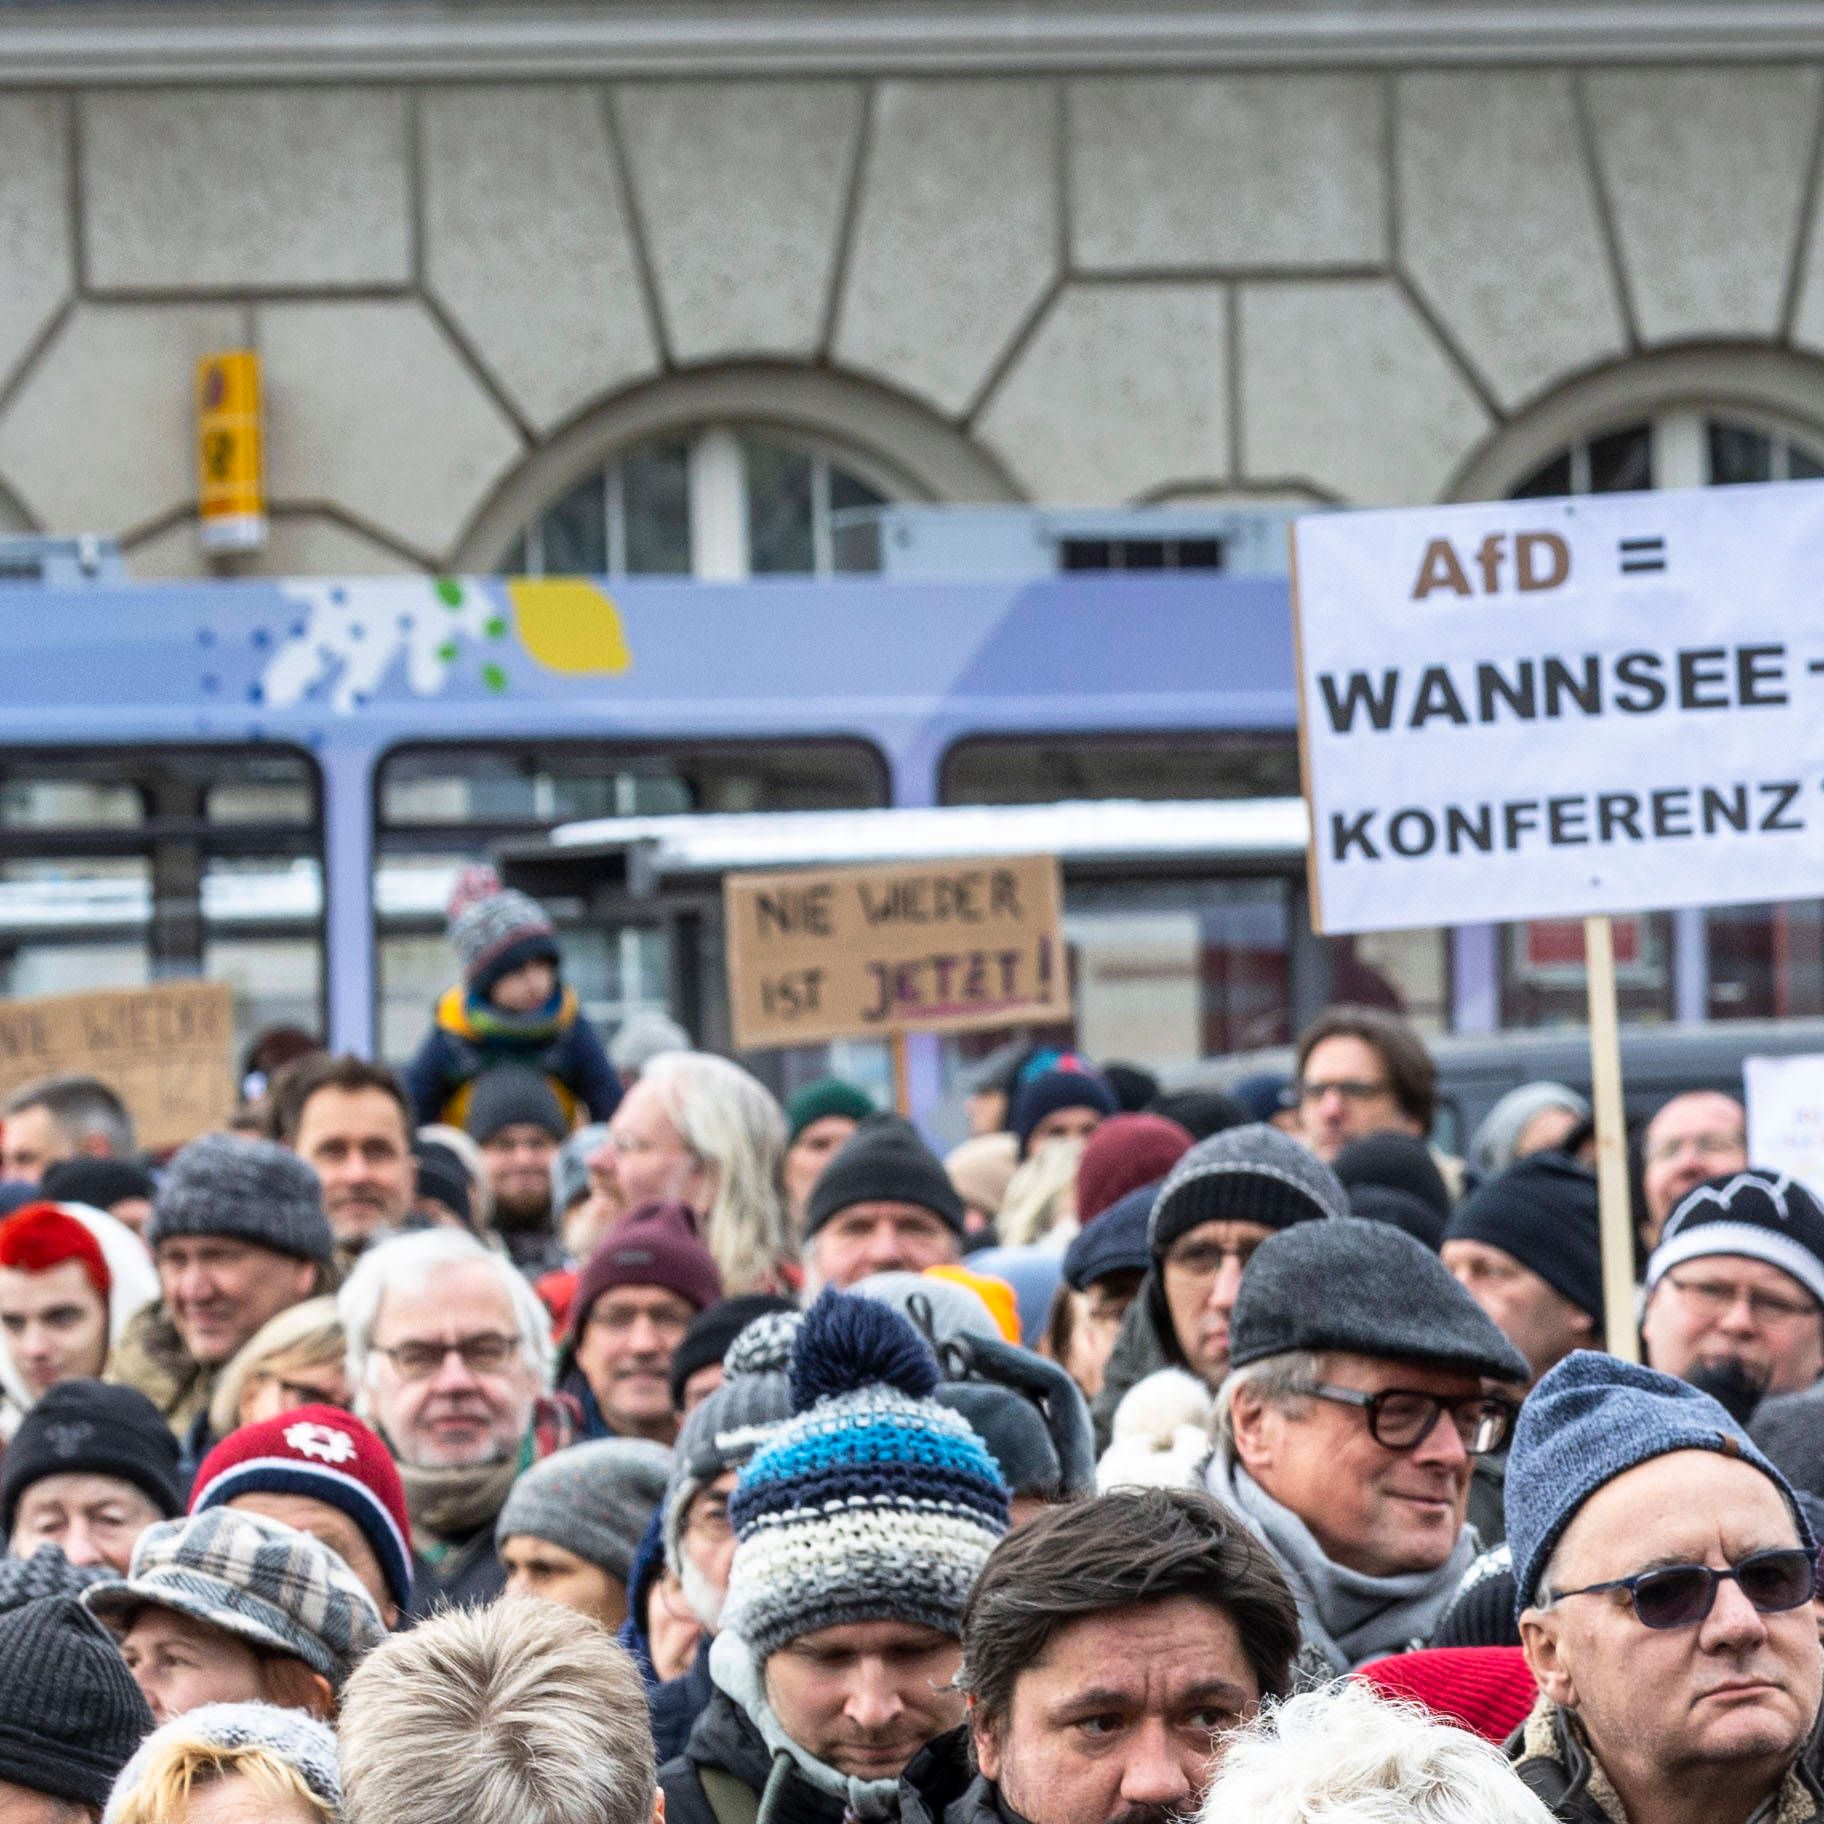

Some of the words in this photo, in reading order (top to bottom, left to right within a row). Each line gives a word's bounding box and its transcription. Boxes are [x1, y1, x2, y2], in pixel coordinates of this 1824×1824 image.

[1411, 530, 1572, 601] AfD
[755, 882, 834, 937] NIE
[856, 868, 1022, 926] WIEDER
[760, 966, 822, 1020] IST
